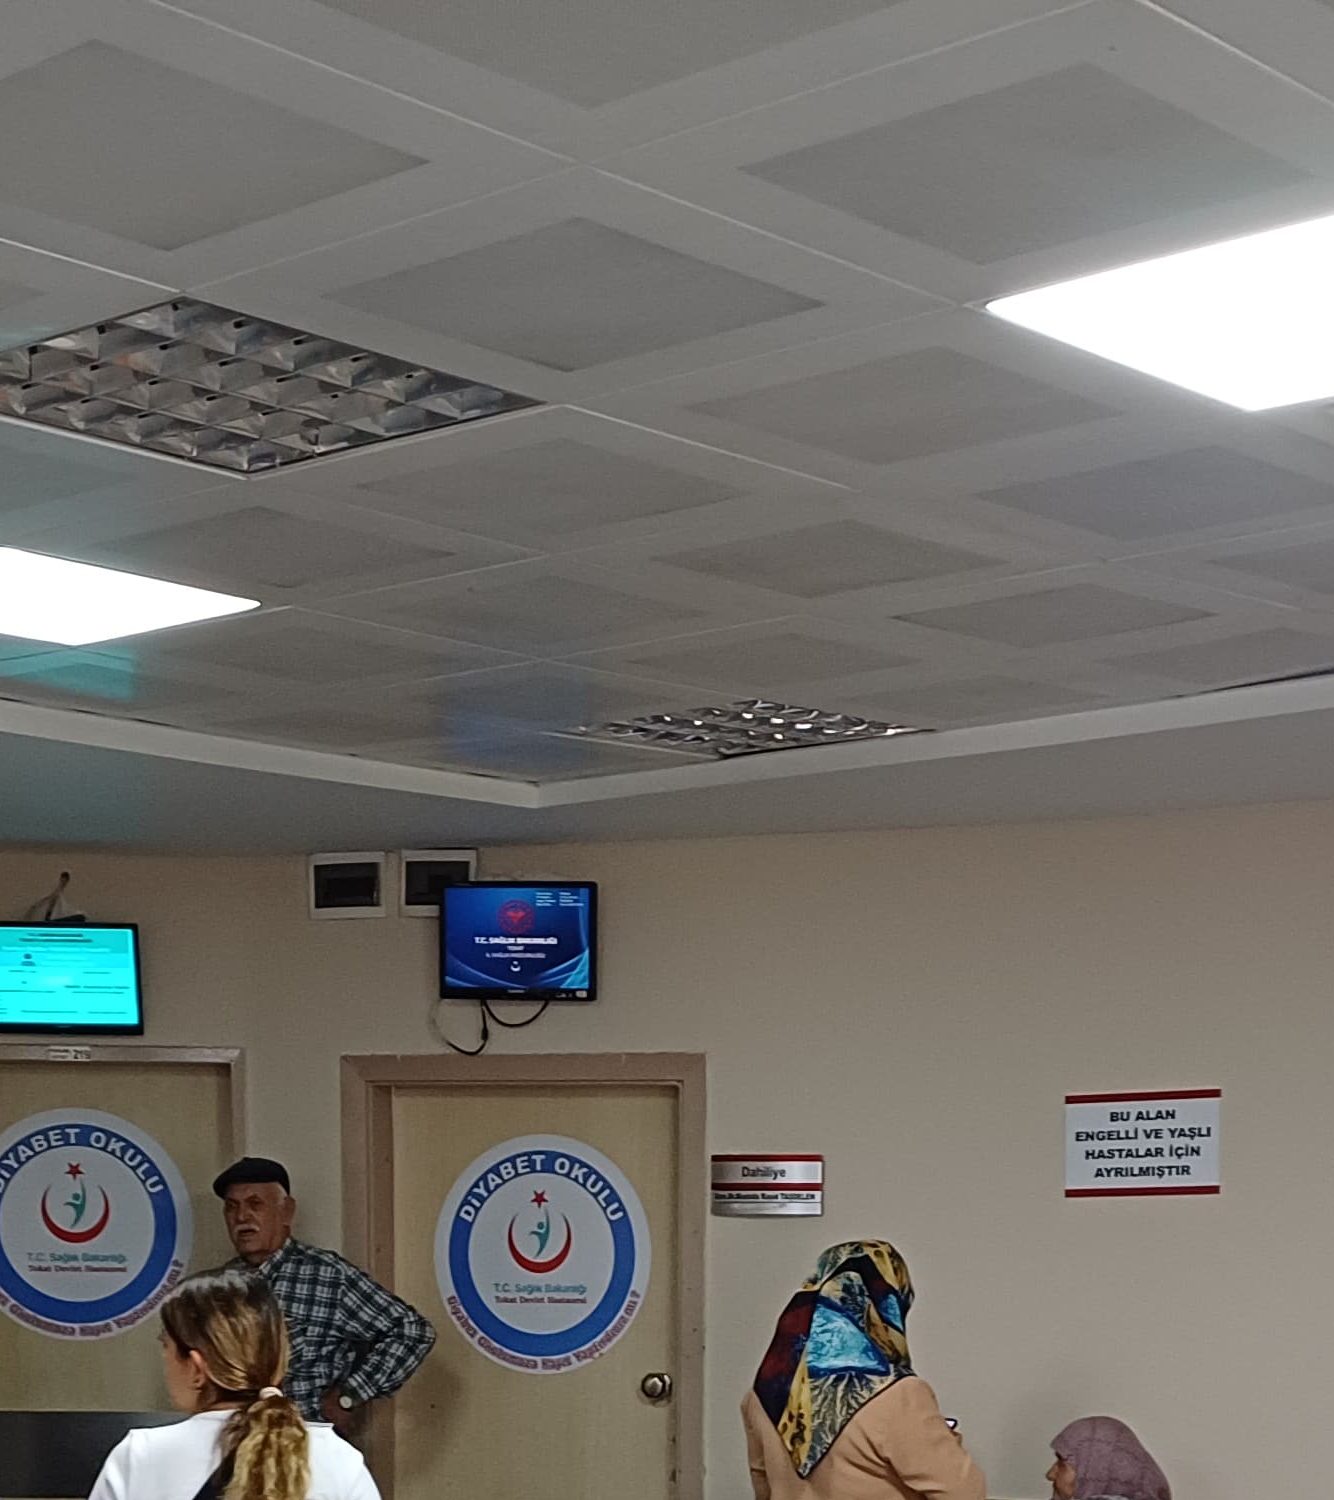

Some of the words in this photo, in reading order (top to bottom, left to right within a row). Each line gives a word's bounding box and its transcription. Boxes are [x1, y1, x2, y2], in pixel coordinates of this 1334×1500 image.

[1110, 1111, 1131, 1122] BU
[1135, 1109, 1176, 1121] ALAN
[1075, 1128, 1138, 1142] ENGELLİ
[1144, 1128, 1164, 1139] VE
[1169, 1126, 1212, 1140] YAŞLI
[1085, 1147, 1164, 1160] HASTALAR
[1169, 1144, 1201, 1159] İÇİN
[89, 1131, 165, 1194] OKULU
[741, 1166, 787, 1180] Dahiliye
[1094, 1165, 1191, 1179] AYRILMIŞTIR
[554, 1157, 625, 1222] OKULU
